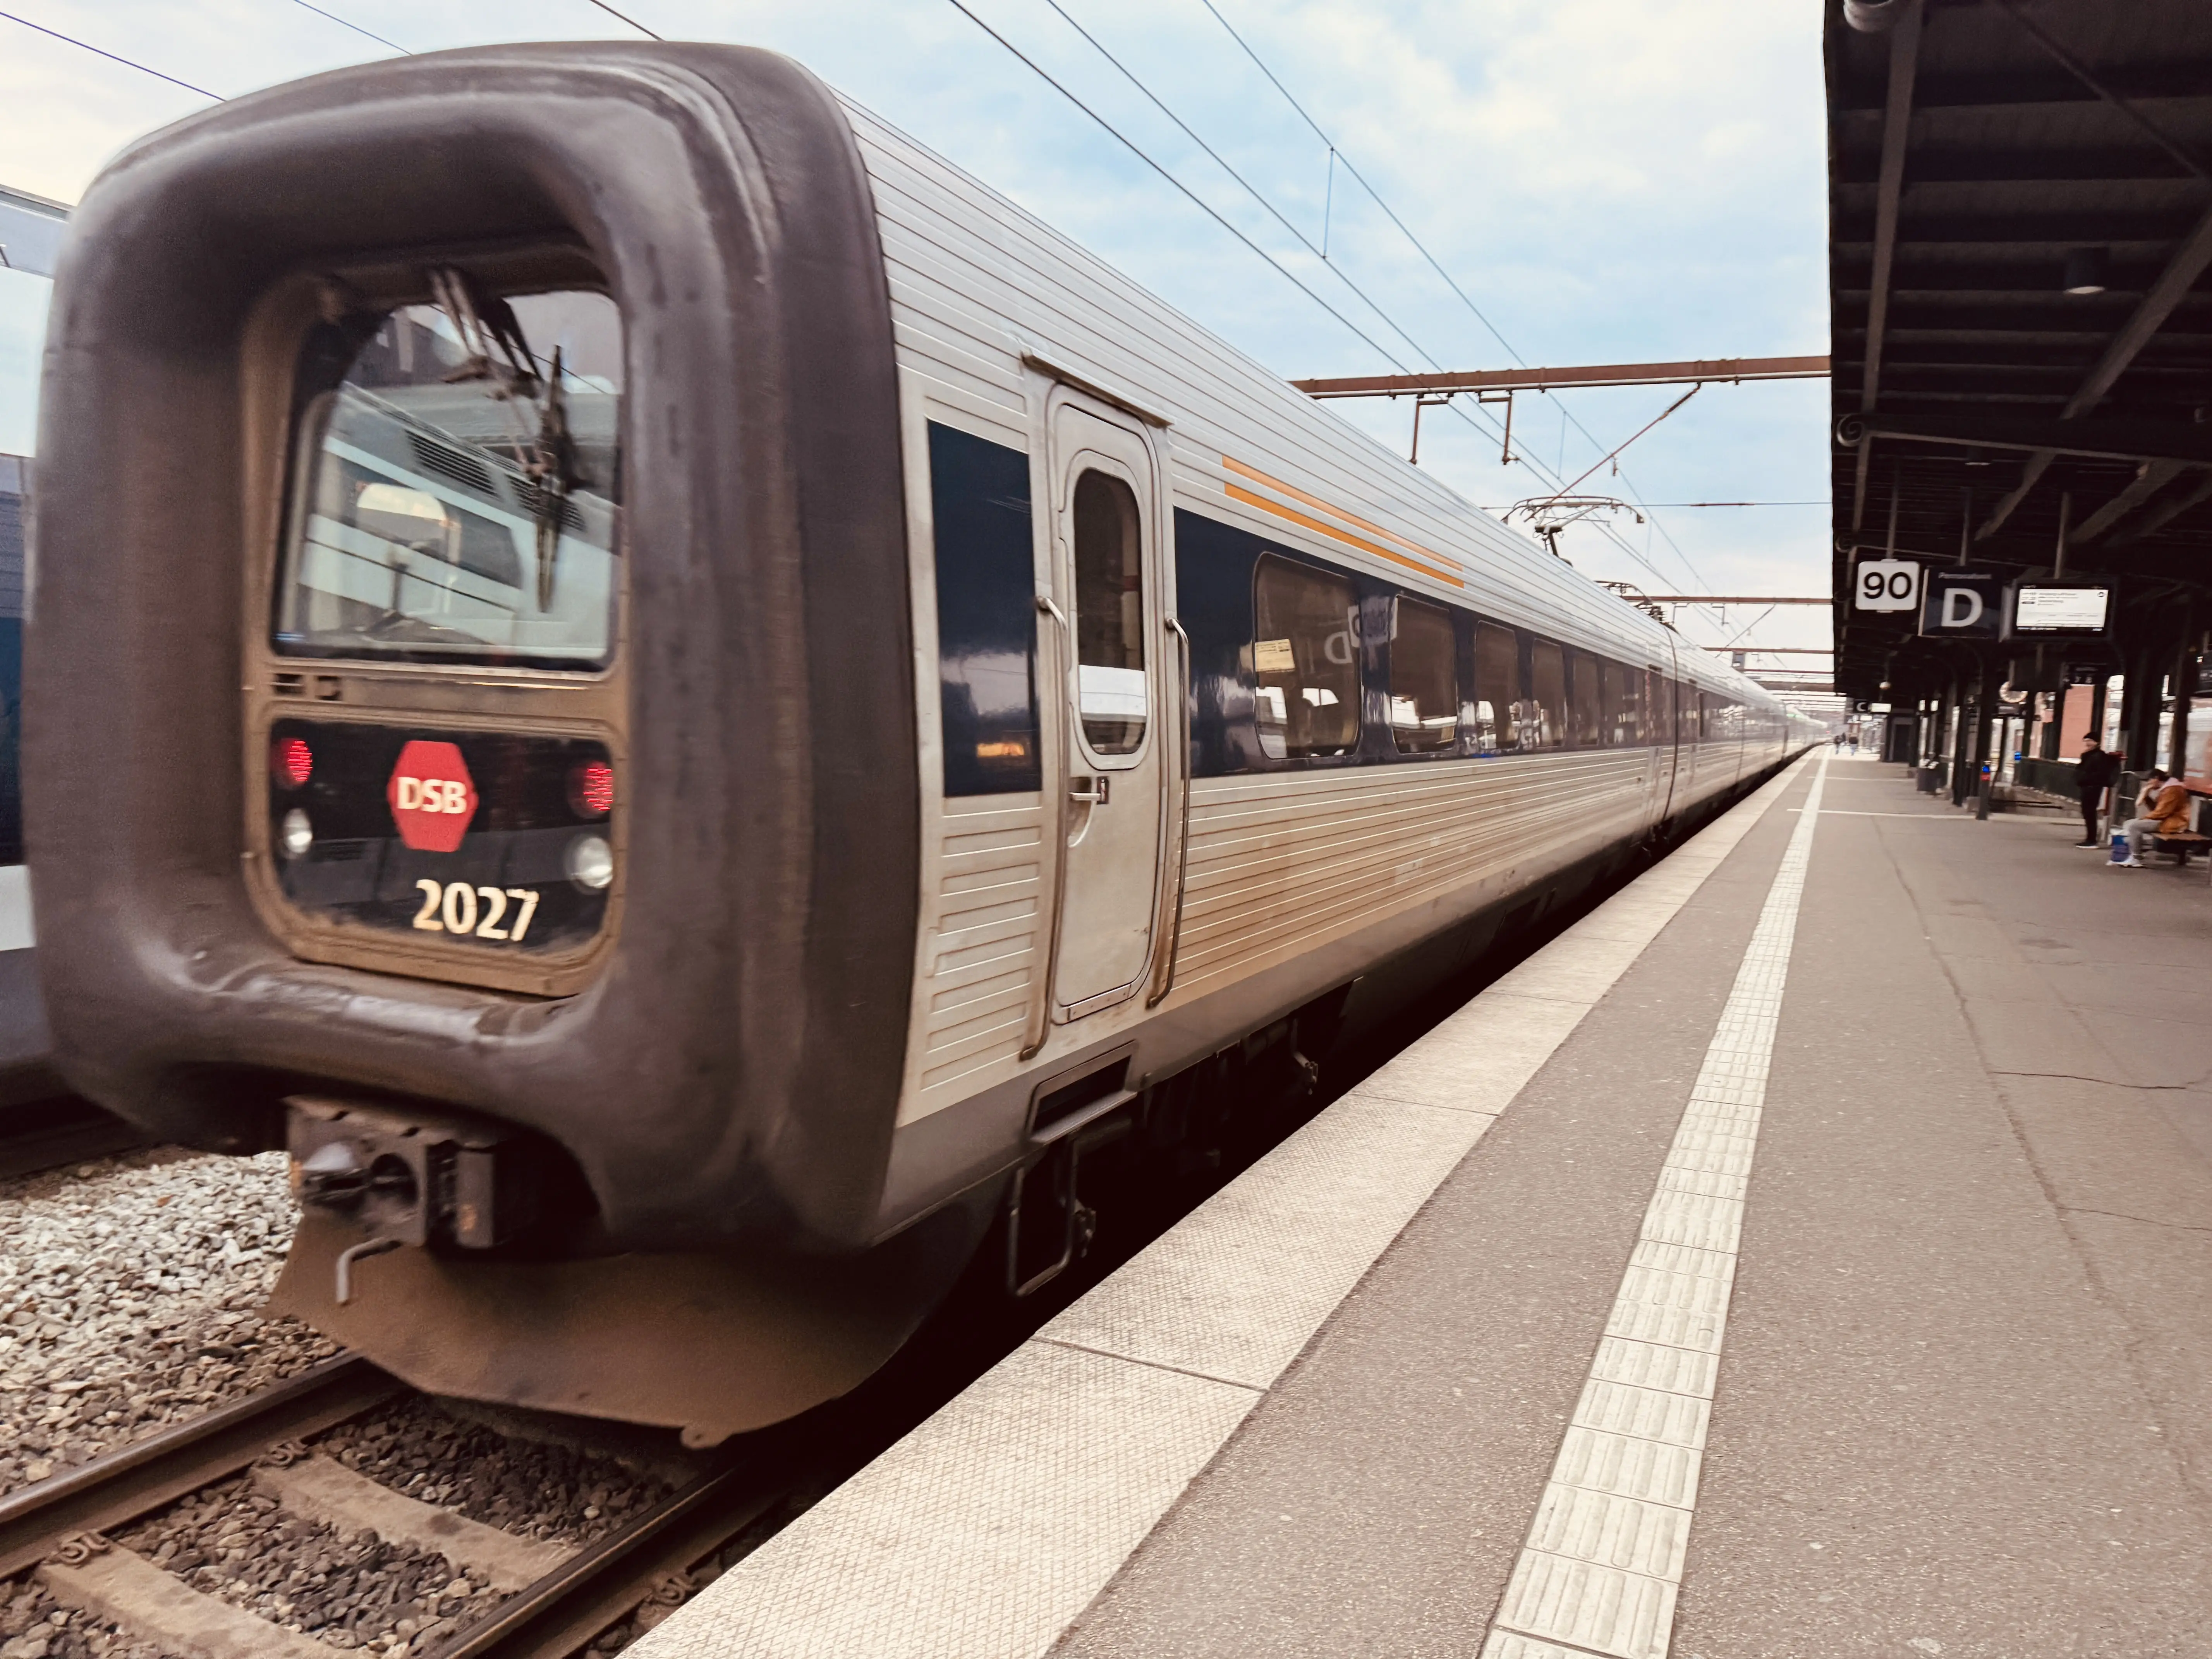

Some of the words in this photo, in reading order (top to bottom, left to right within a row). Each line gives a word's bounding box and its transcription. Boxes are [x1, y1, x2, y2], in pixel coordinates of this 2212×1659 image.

[1863, 571, 1912, 600] 90
[1941, 588, 1983, 627] D
[1856, 702, 1867, 711] C
[396, 776, 468, 814] DSB
[412, 878, 539, 942] 2027
